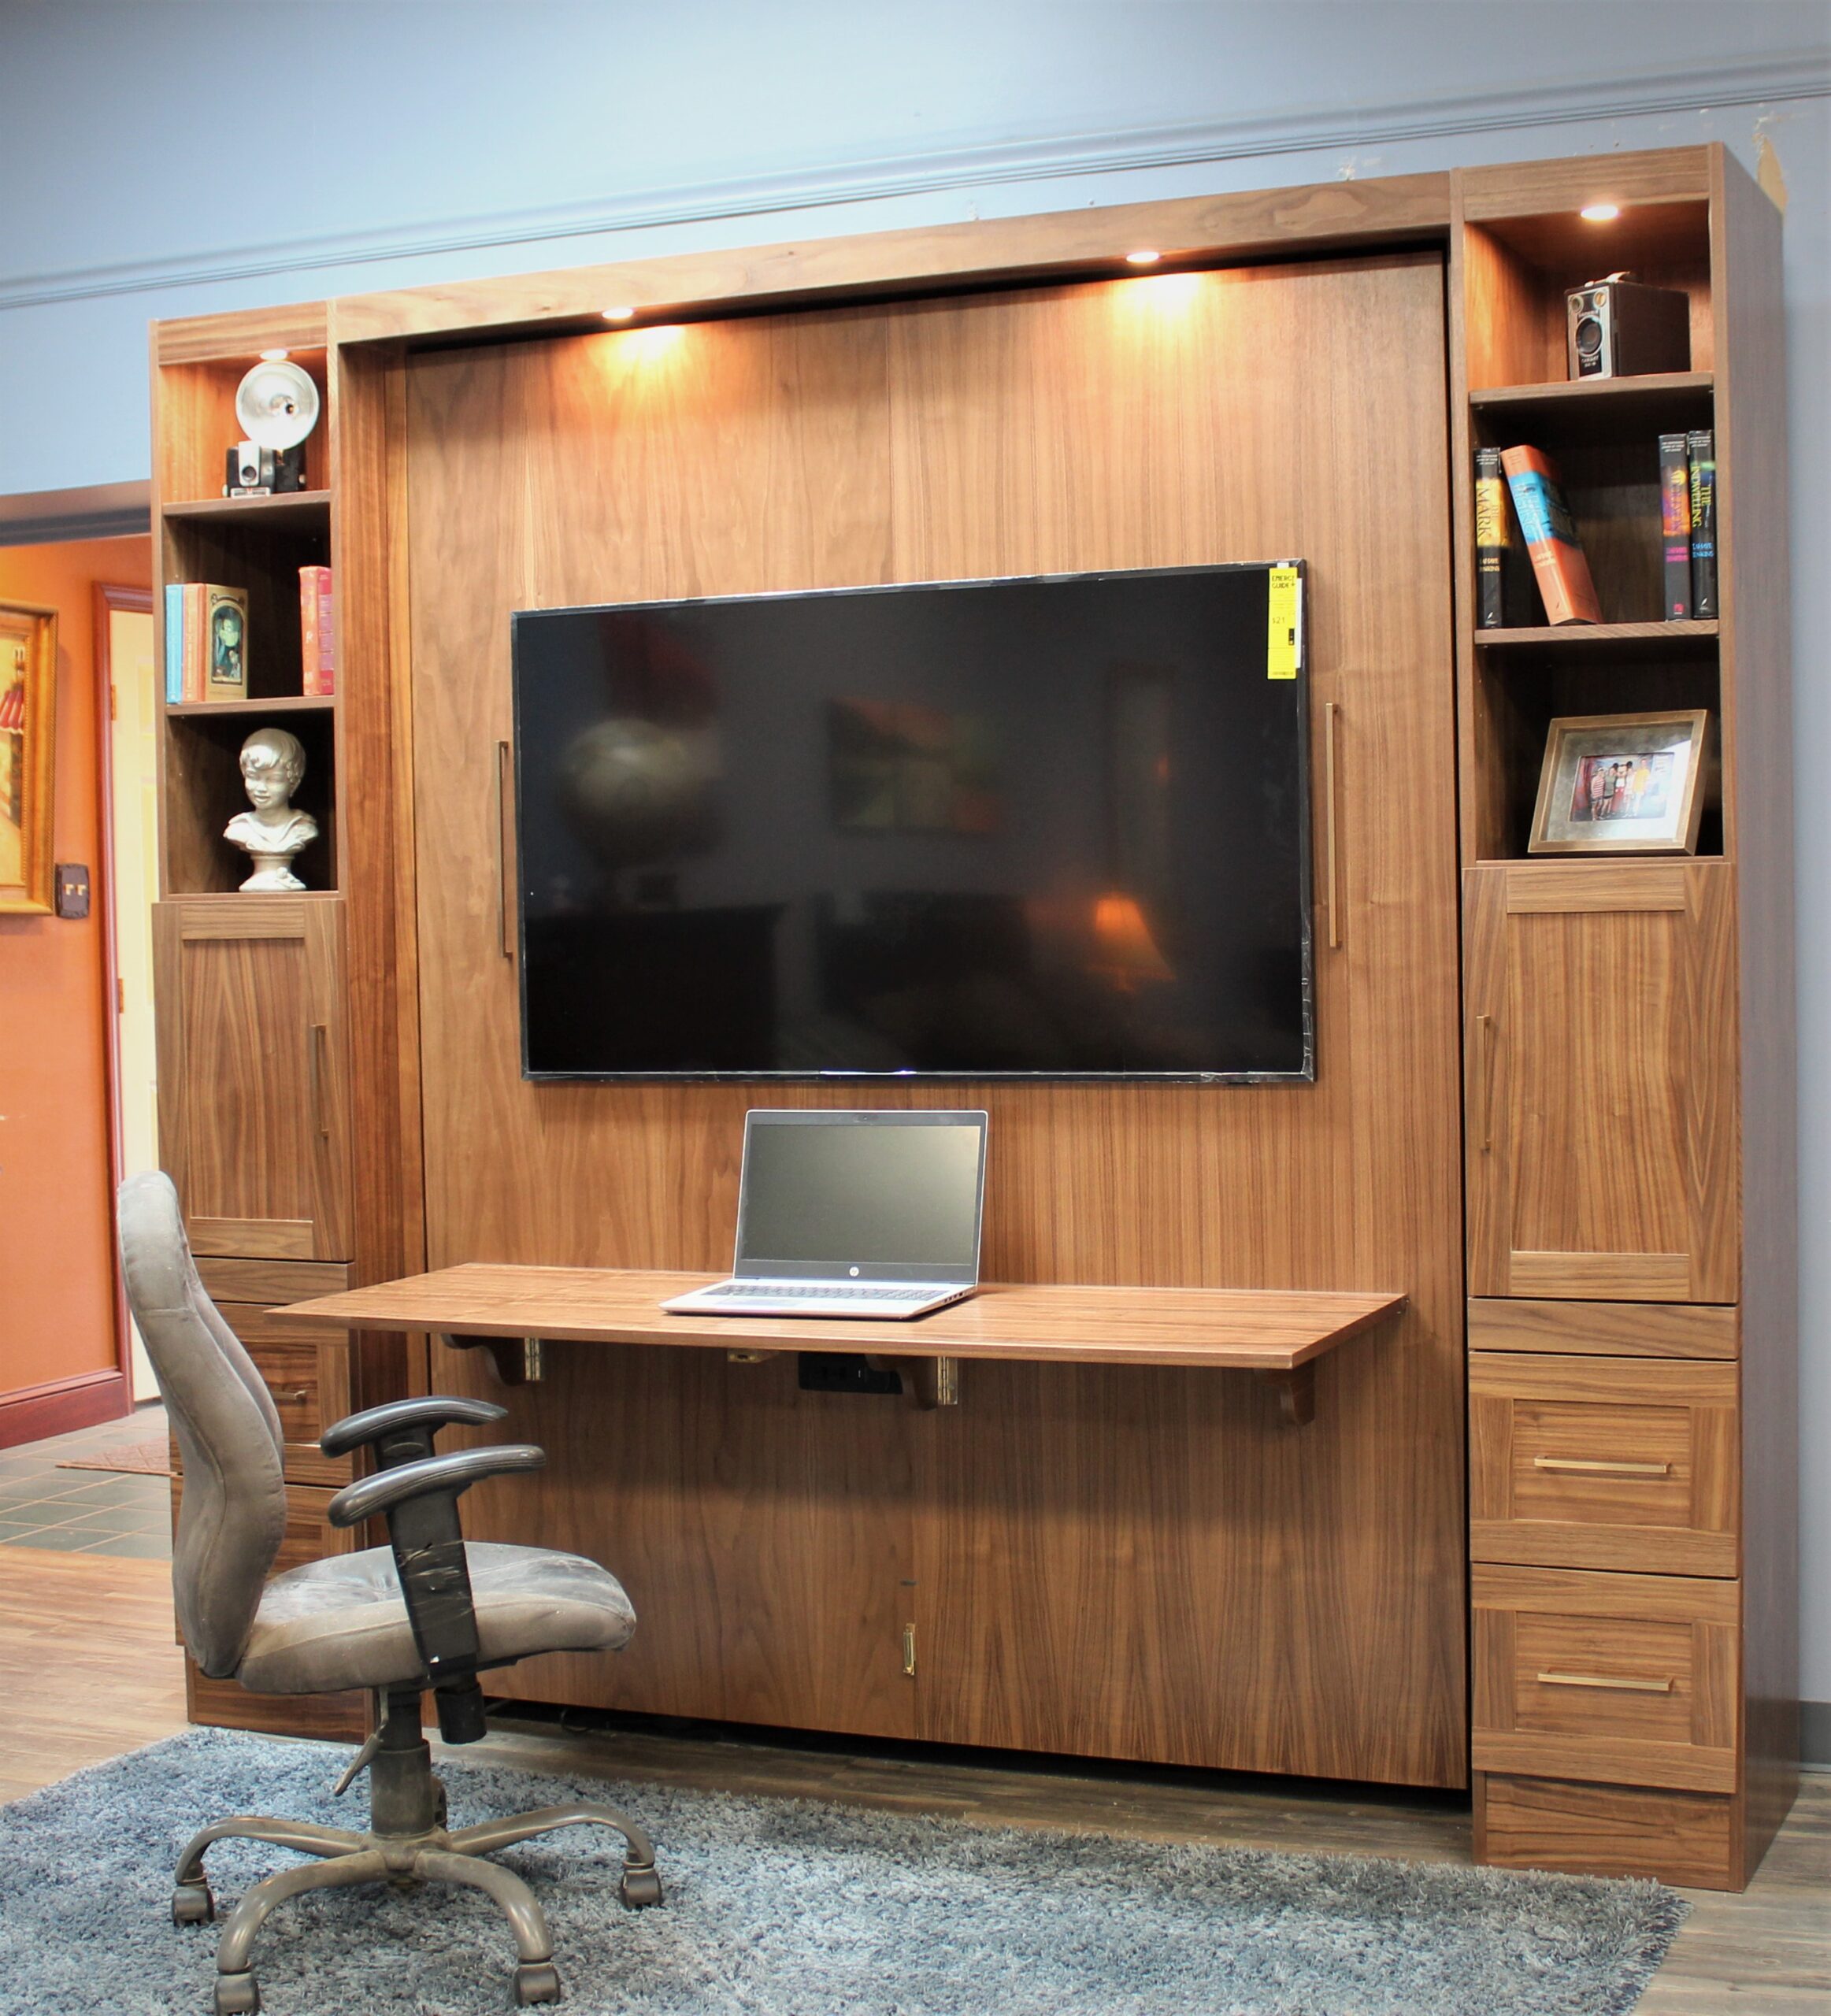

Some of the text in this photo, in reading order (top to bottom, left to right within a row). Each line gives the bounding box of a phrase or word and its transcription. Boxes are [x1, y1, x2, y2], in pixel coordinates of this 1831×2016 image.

[1477, 488, 1492, 539] MARK
[1690, 465, 1702, 528] INDWELLING
[1701, 486, 1712, 506] THE
